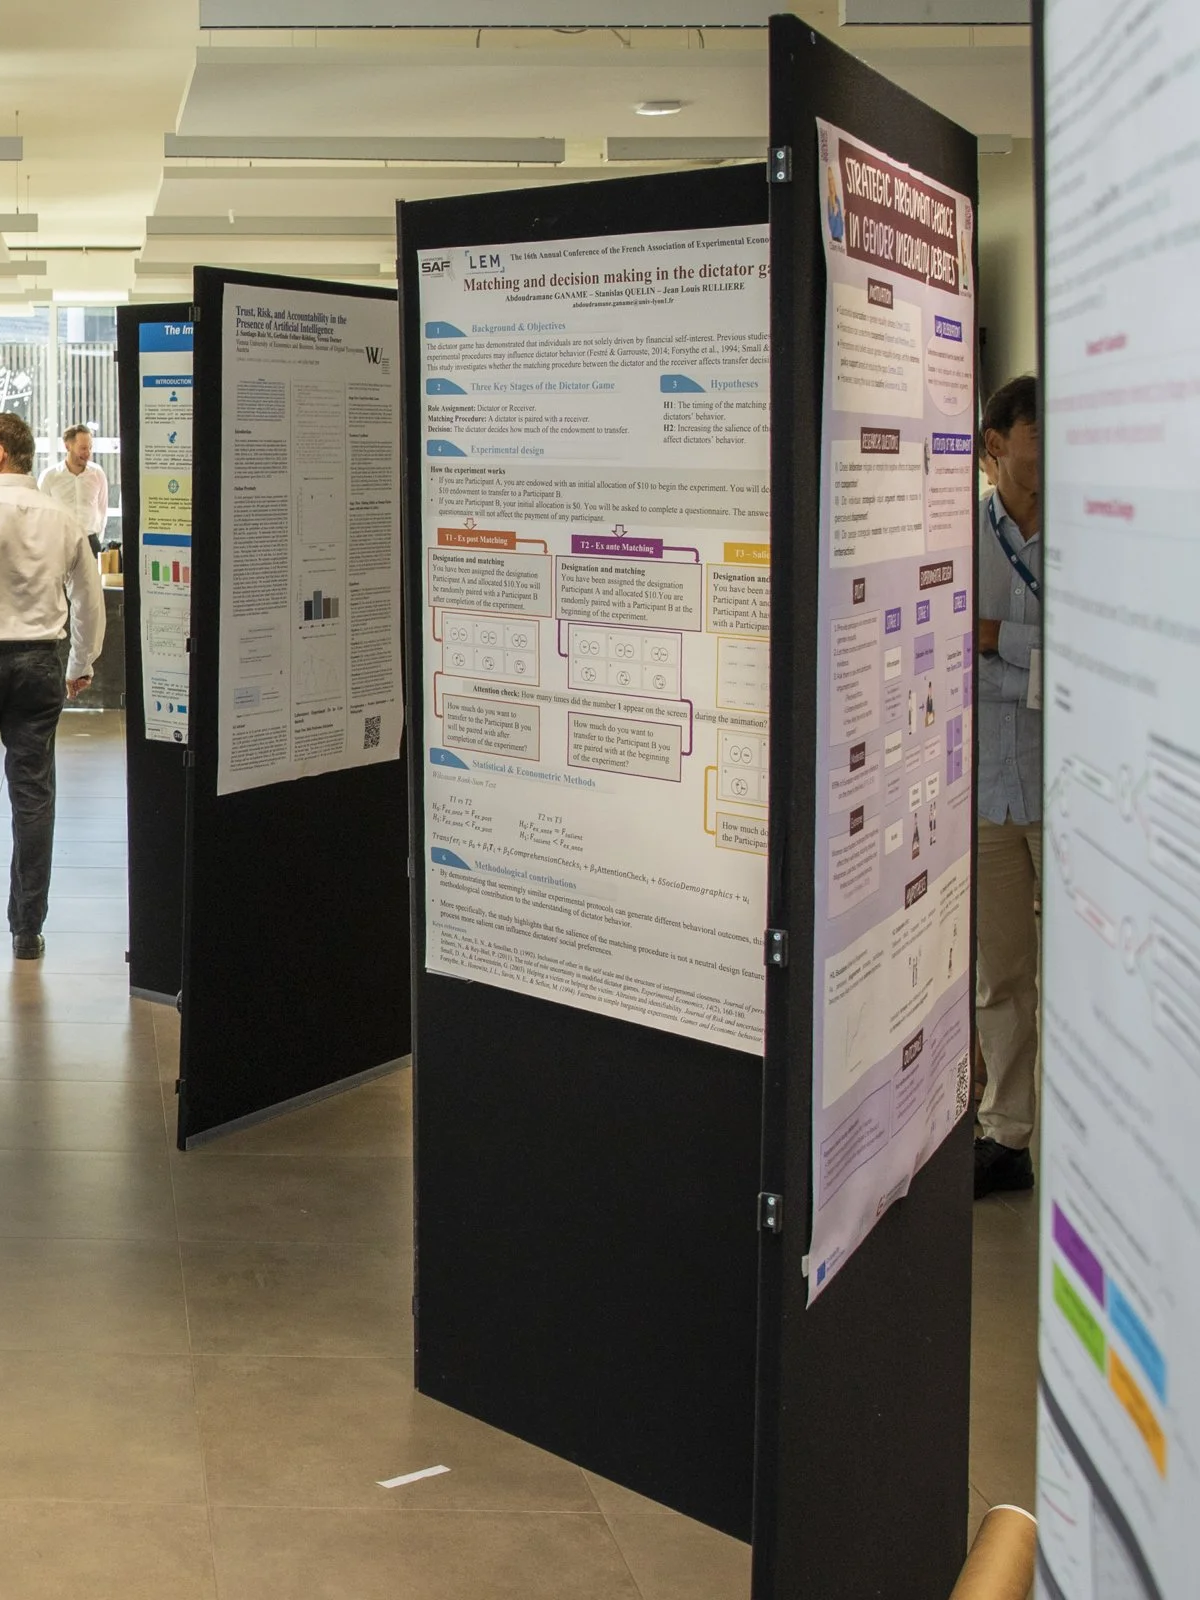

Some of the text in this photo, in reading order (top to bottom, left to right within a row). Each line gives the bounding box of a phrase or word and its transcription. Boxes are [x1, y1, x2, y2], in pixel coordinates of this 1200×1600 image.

[844, 156, 891, 208] STRATEGIC
[894, 177, 931, 228] ARGUMENT
[931, 196, 954, 239] CHOICE
[511, 252, 522, 260] The
[524, 251, 537, 260] 16th
[539, 249, 561, 259] Annual
[563, 248, 599, 257] Conference
[601, 246, 608, 254] of
[609, 245, 619, 254] the
[621, 243, 645, 253] French
[647, 241, 685, 251] Association
[687, 240, 694, 249] of
[696, 237, 744, 249] Experimental
[850, 212, 955, 287] IN GENDER INEQUALITY DEBATES
[421, 260, 450, 273] SAF
[469, 254, 501, 270] LEM
[464, 276, 519, 292] Matching
[523, 274, 545, 289] and
[550, 272, 599, 287] decision
[604, 270, 651, 286] making
[656, 268, 668, 282] in
[673, 267, 694, 281] the
[699, 265, 753, 280] dictator
[506, 282, 744, 302] Abdoudramane GANAME Stanislas QUELIN Jean Louis RULLIERE
[236, 306, 346, 324] Trust, Risk, and Accountability in the
[164, 325, 180, 335] The
[236, 319, 333, 335] Presence of Artificial Intelligence
[472, 323, 515, 334] Background
[518, 322, 524, 331] &
[527, 321, 565, 333] Objectives
[472, 382, 491, 391] Three
[493, 382, 506, 393] Key
[510, 382, 533, 393] Stages
[535, 382, 542, 390] of
[545, 382, 556, 390] the
[559, 381, 589, 390] Dictator
[591, 381, 614, 390] Game
[711, 379, 758, 390] Hypotheses
[692, 401, 713, 411] timing
[735, 401, 766, 411] matching
[678, 424, 711, 434] Increasing
[471, 445, 518, 456] Experimental
[520, 445, 544, 456] design
[581, 541, 653, 554] T2 Ex ante Matching
[561, 562, 645, 577] Designation and matching
[561, 574, 683, 590] You have been assigned the designation
[561, 585, 593, 596] Participant
[595, 587, 600, 595] A
[602, 588, 613, 596] and
[615, 588, 643, 598] allocated
[644, 590, 672, 600] $10.You
[561, 596, 589, 608] randomly
[590, 598, 610, 608] paired
[612, 600, 625, 608] with
[632, 600, 666, 612] Participant
[668, 603, 673, 611] B
[674, 603, 680, 612] at
[682, 604, 692, 612] the
[561, 607, 648, 621] beginning of the experiment.
[472, 760, 505, 774] Statistical
[507, 765, 513, 775] &
[516, 766, 560, 781] Econometric
[563, 773, 595, 786] Methods
[474, 860, 527, 879] Methodological
[529, 873, 576, 888] contributions
